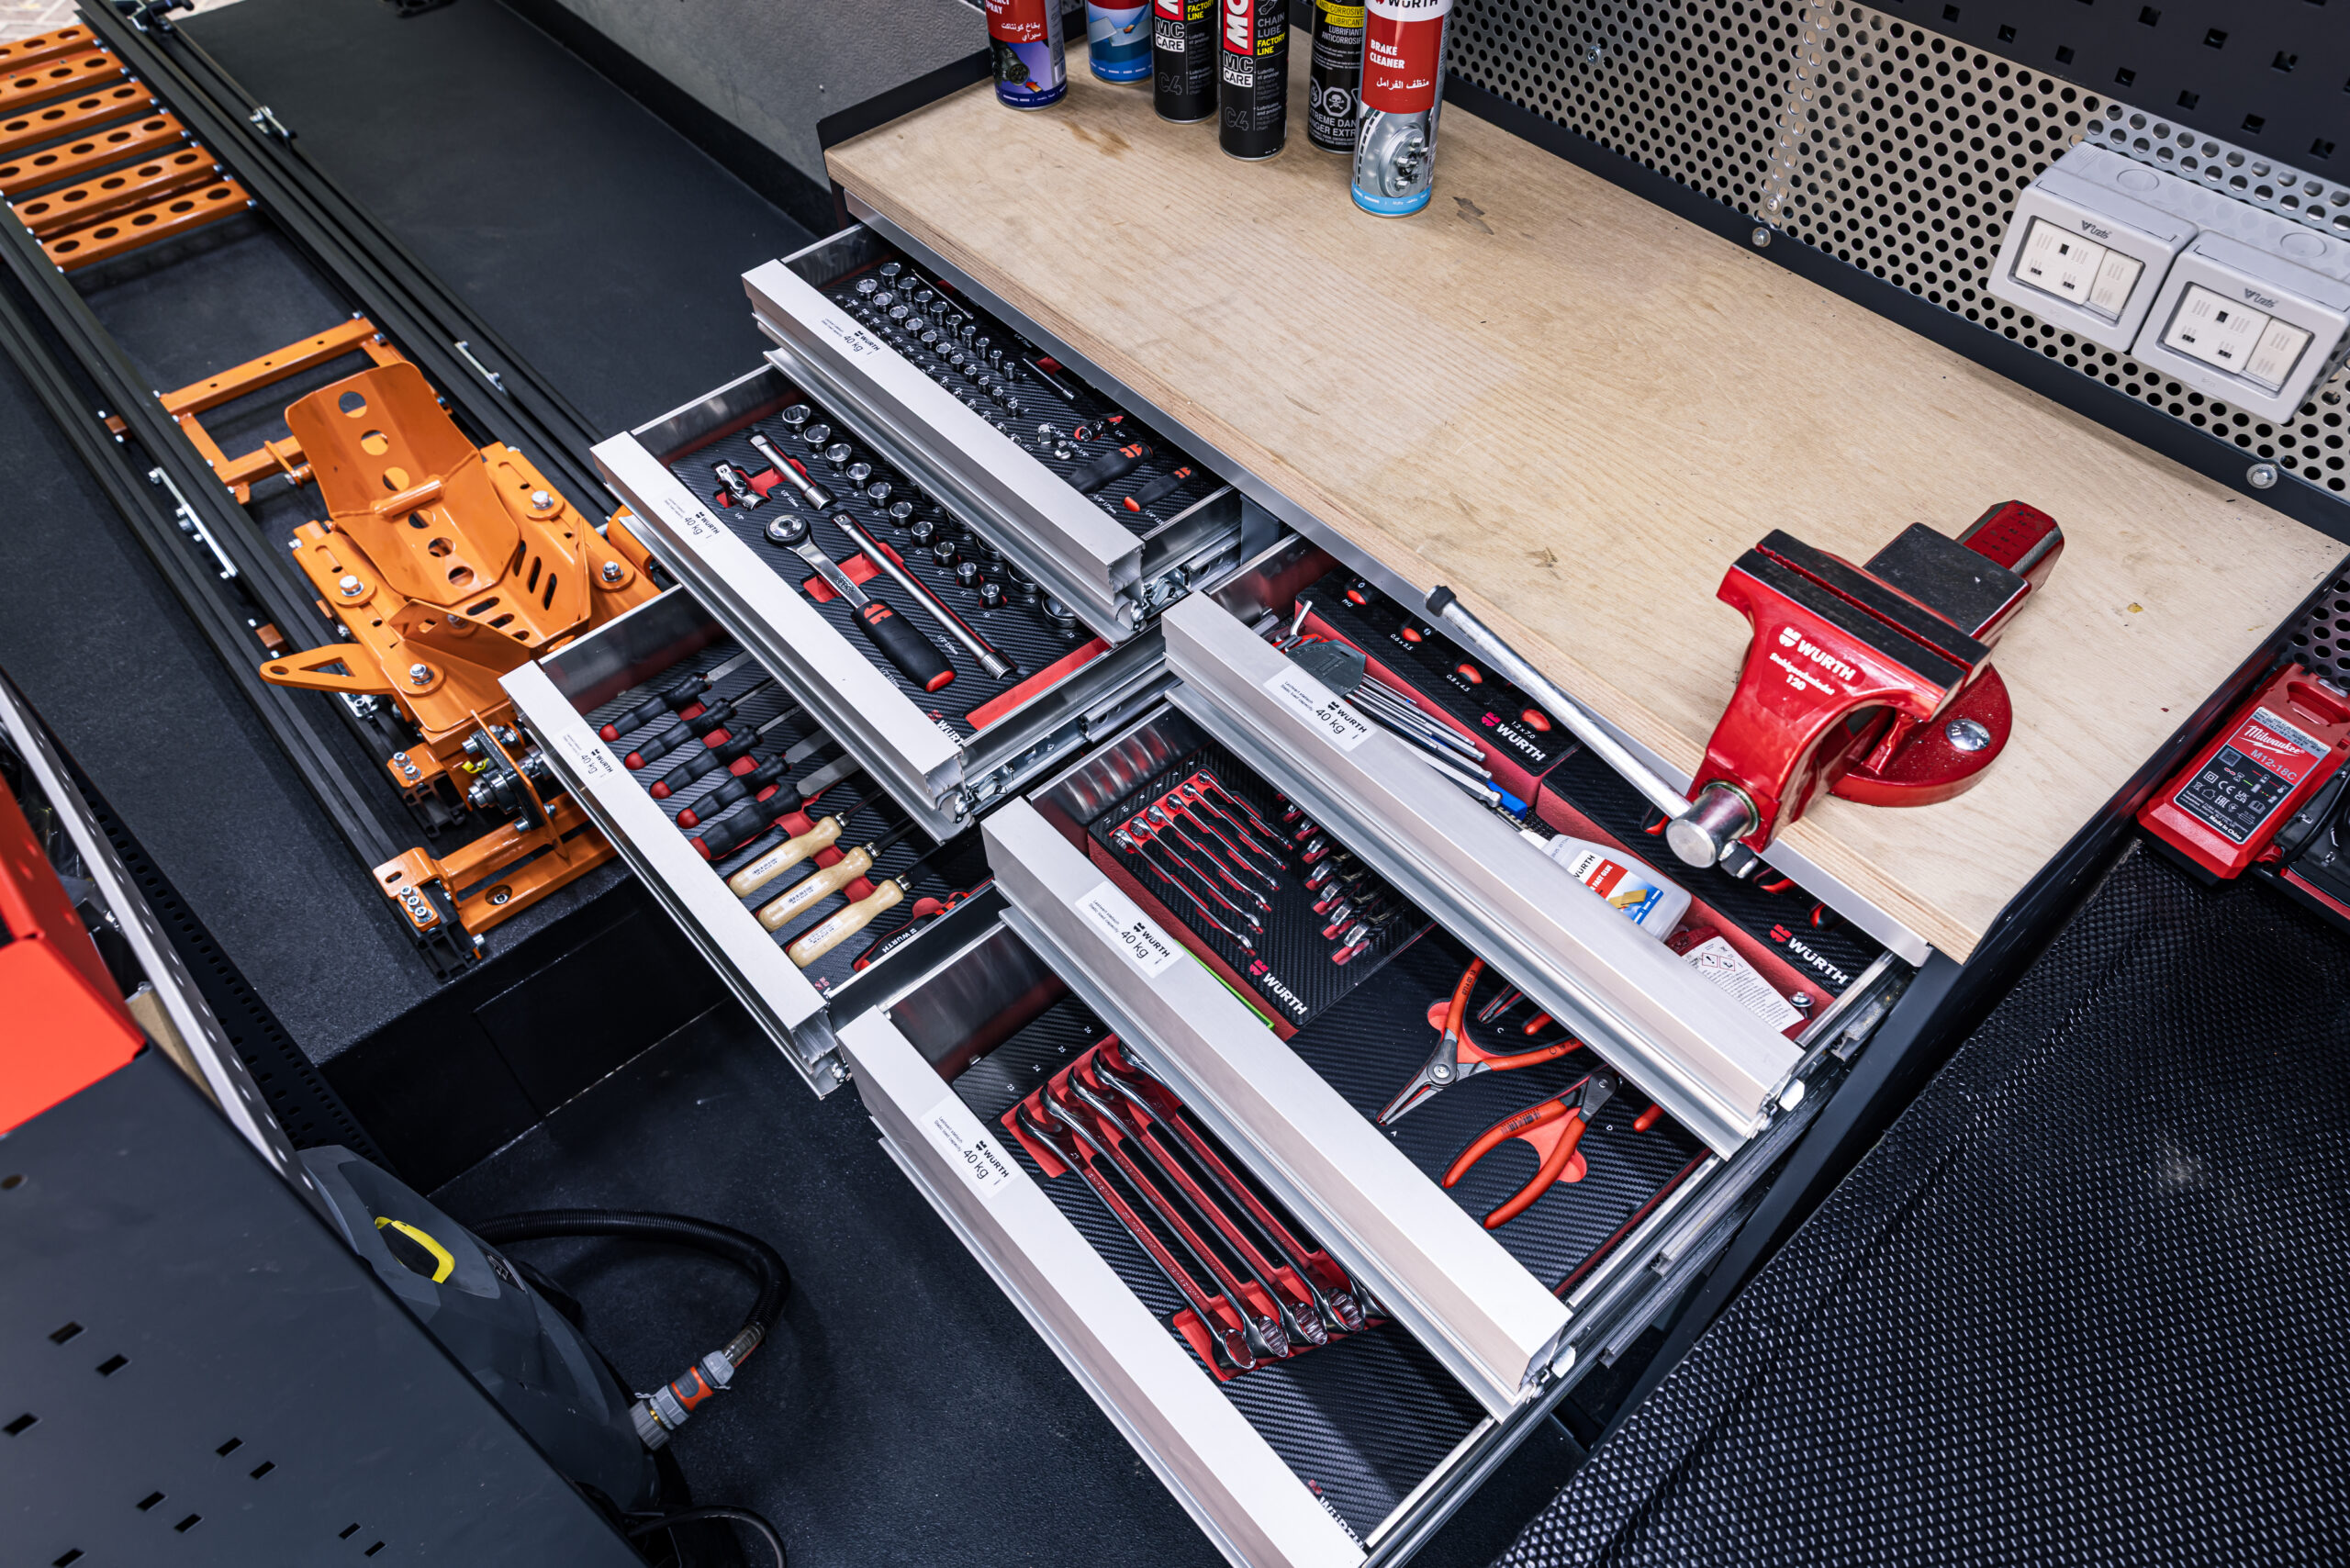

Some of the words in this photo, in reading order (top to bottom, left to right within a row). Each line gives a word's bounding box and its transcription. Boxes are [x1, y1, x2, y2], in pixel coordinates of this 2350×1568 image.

[1188, 11, 1204, 21] LINE
[1258, 12, 1285, 28] CHAIN
[1330, 16, 1364, 27] LUBRICANT
[1155, 17, 1185, 39] MC
[1258, 25, 1281, 39] LUBE
[1328, 26, 1362, 36] LUBRIFIANT
[1157, 34, 1184, 51] CARE
[1257, 32, 1285, 48] FACTORY
[1322, 31, 1362, 45] ANTICORROSIF
[1257, 46, 1274, 55] LINE
[1370, 39, 1398, 56] BRAKE
[1223, 50, 1254, 73] MC
[1370, 51, 1405, 69] CLEANER
[1158, 73, 1183, 95] C4
[1224, 67, 1253, 87] CARE
[1376, 77, 1404, 90] الفرامل
[1406, 78, 1429, 90] منظف
[1225, 106, 1249, 130] C4
[844, 334, 856, 344] 40
[853, 340, 864, 353] kg
[684, 516, 696, 527] 40
[692, 524, 703, 535] kg
[1341, 598, 1354, 608] PH2
[1391, 633, 1400, 642] 0.6
[1403, 642, 1414, 651] 3.5
[1446, 674, 1457, 682] 0.8
[1460, 683, 1471, 692] 4.5
[1315, 709, 1332, 722] 40
[1328, 719, 1346, 734] kg
[1511, 721, 1521, 729] 1.2
[1524, 730, 1536, 739] 7.0
[1496, 723, 1547, 762] WÜRTH
[2244, 724, 2302, 755] Milwaukee
[581, 755, 592, 764] 40
[588, 762, 599, 775] kg
[2251, 749, 2299, 781] M12-18C
[2209, 814, 2223, 826] Made
[1592, 875, 1605, 890] FAST
[1602, 864, 1614, 878] GLUE
[1121, 931, 1136, 945] 40
[1133, 941, 1149, 959] kg
[1788, 937, 1849, 985] WÜRTH
[1263, 972, 1308, 1015] WÜRTH
[1084, 1025, 1092, 1034] 26
[1058, 1045, 1066, 1053] 25
[1033, 1064, 1041, 1072] 24
[1006, 1083, 1015, 1092] 23
[963, 1149, 978, 1164] 40
[974, 1161, 989, 1180] kg
[983, 1149, 1010, 1178] WÜRTH
